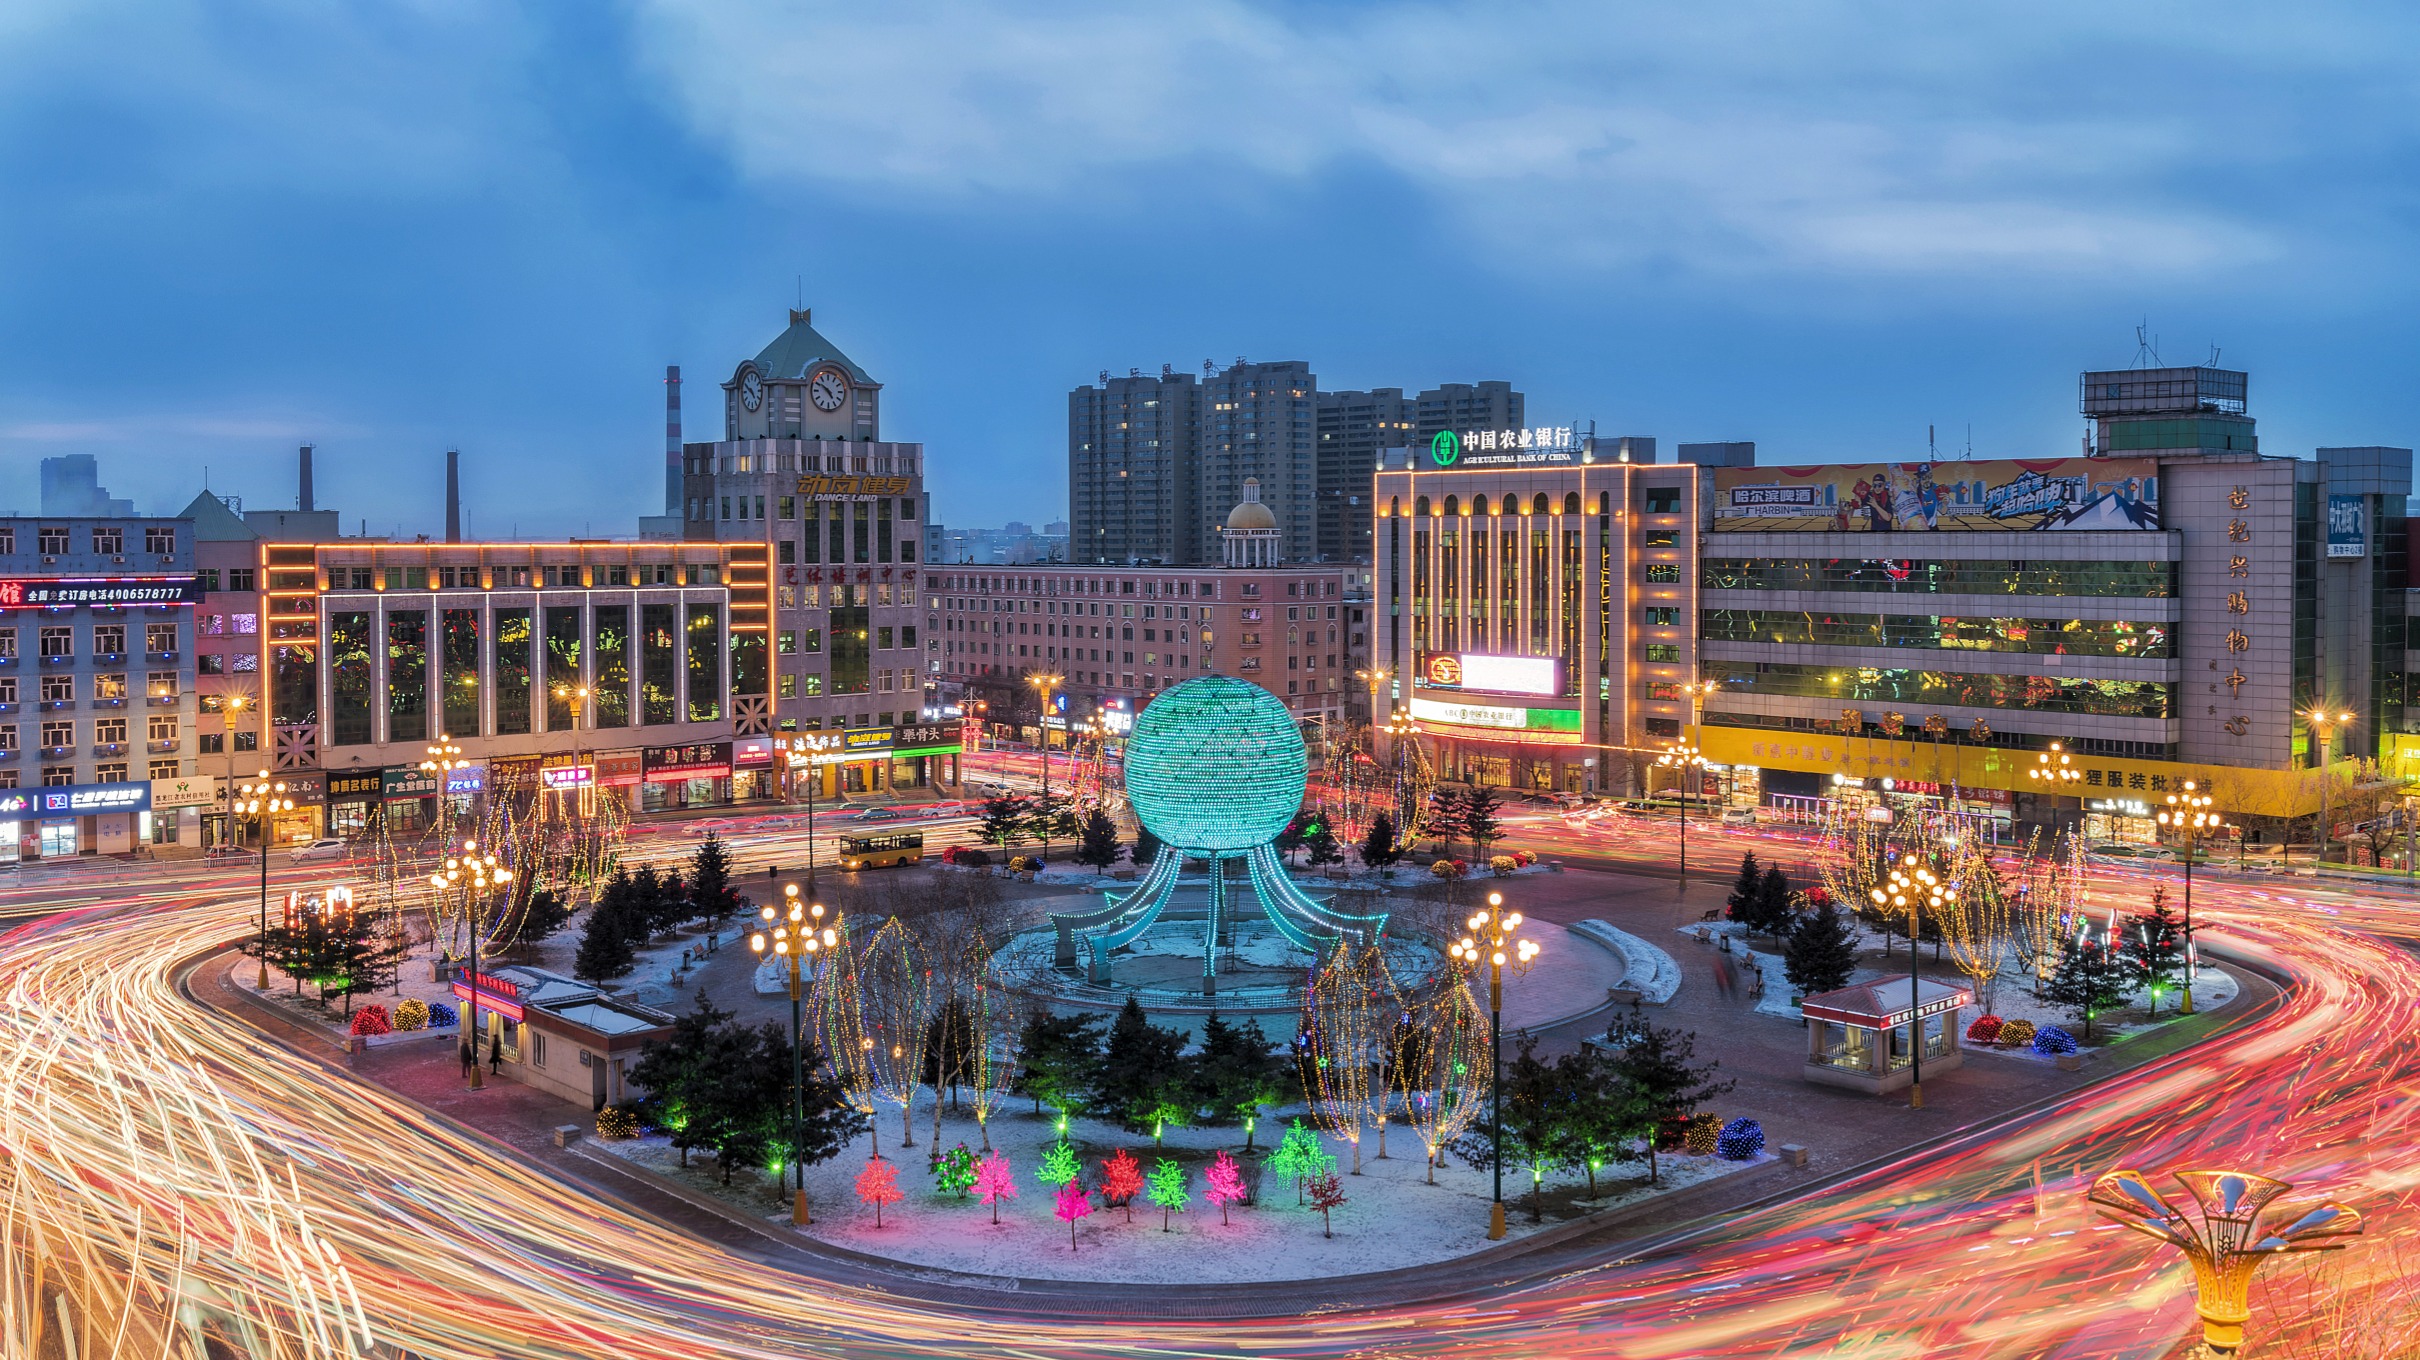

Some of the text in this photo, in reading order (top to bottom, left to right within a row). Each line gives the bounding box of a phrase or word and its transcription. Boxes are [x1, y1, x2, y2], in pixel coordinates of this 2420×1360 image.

[1463, 427, 1571, 450] 中国农业银行
[1463, 455, 1516, 464] AGRICULTURAL
[1517, 454, 1537, 462] BANK
[1549, 453, 1571, 461] CHINA
[815, 493, 878, 502] DANCE LAND
[1735, 489, 1811, 503] 哈尔滨啤酒
[1986, 475, 2045, 510] 狗年就要
[1754, 505, 1792, 515] HARBIN
[2223, 484, 2251, 737] 世纪兴购物中心
[155, 791, 210, 802] 黑龙江省农村信用社
